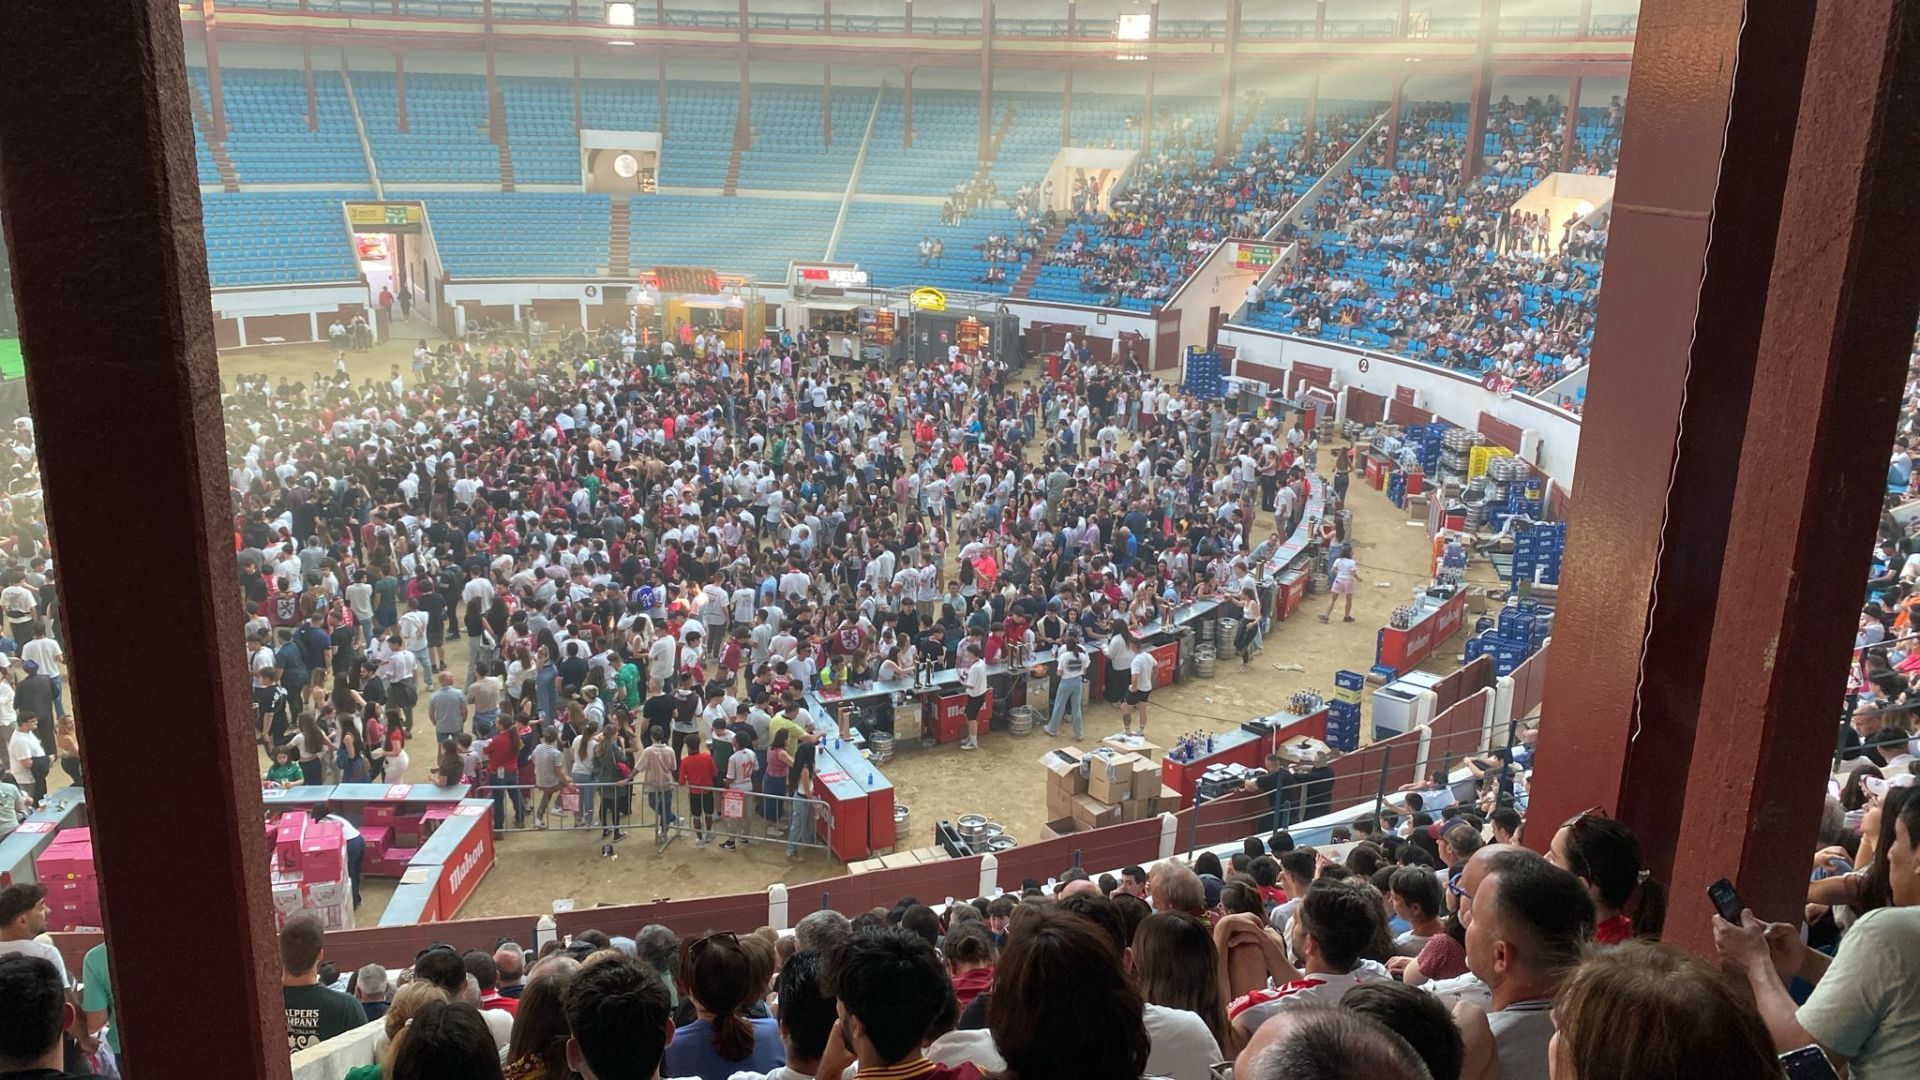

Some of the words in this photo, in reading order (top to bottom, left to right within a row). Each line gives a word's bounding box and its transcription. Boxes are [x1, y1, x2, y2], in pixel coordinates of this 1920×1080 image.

[1361, 360, 1367, 371] 2
[449, 838, 484, 895] Mahou
[287, 1017, 320, 1027] MPANY
